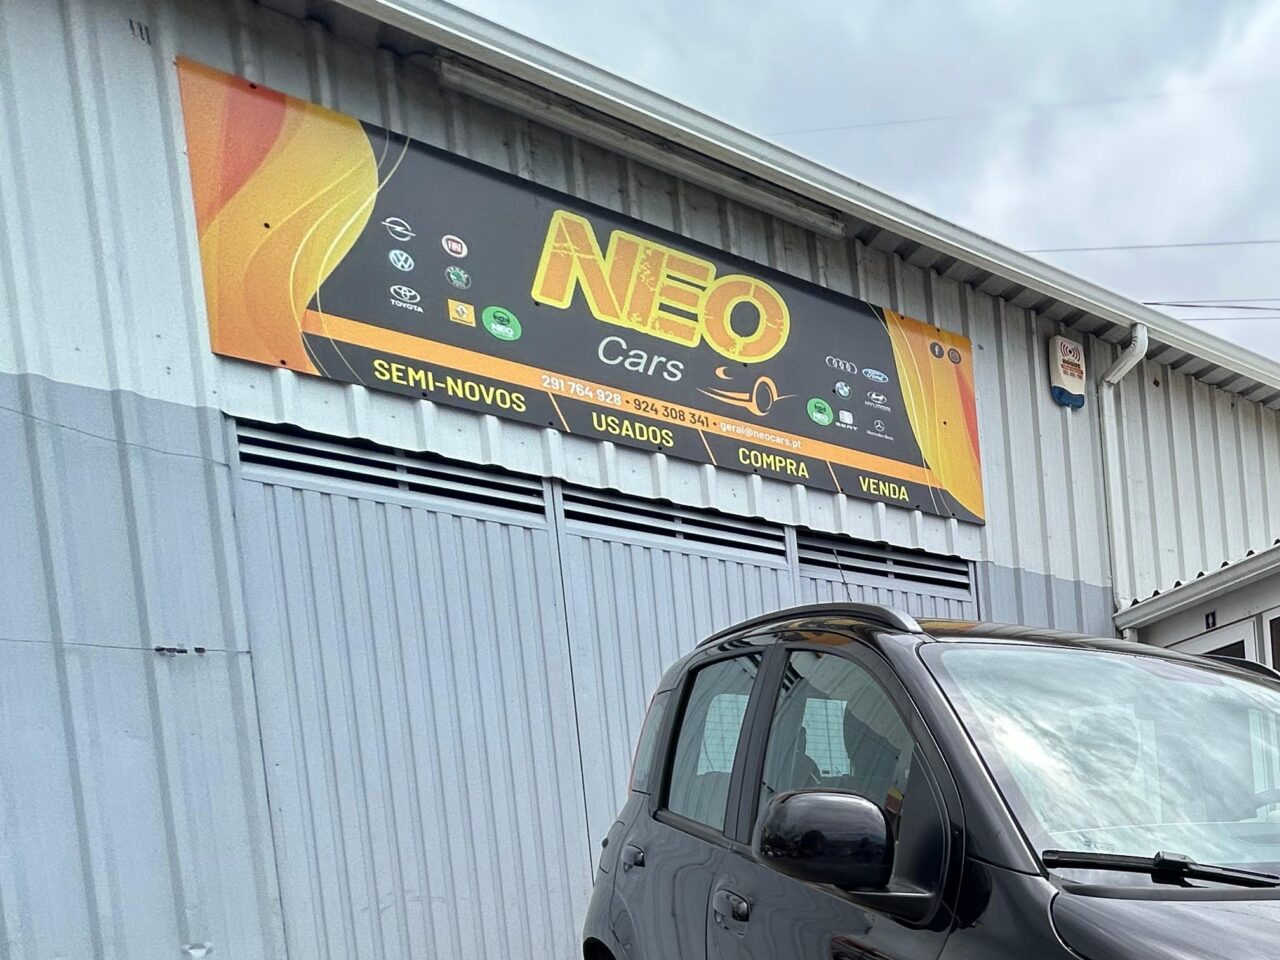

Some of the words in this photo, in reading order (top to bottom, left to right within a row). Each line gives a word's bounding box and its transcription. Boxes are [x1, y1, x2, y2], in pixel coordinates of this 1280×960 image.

[390, 299, 424, 313] TOYOTA
[531, 210, 790, 363] NEO
[598, 336, 684, 382] Cars
[374, 358, 527, 413] SEMI-NOVOS
[541, 374, 566, 392] 291
[569, 381, 594, 399] 764
[596, 388, 622, 406] 928
[633, 398, 659, 416] 924
[662, 405, 687, 422] 308
[689, 412, 710, 428] 341
[719, 420, 802, 450] geral@neocars.pt
[592, 412, 674, 447] USADOS
[738, 447, 809, 479] COMPRA
[858, 476, 910, 502] VENDA
